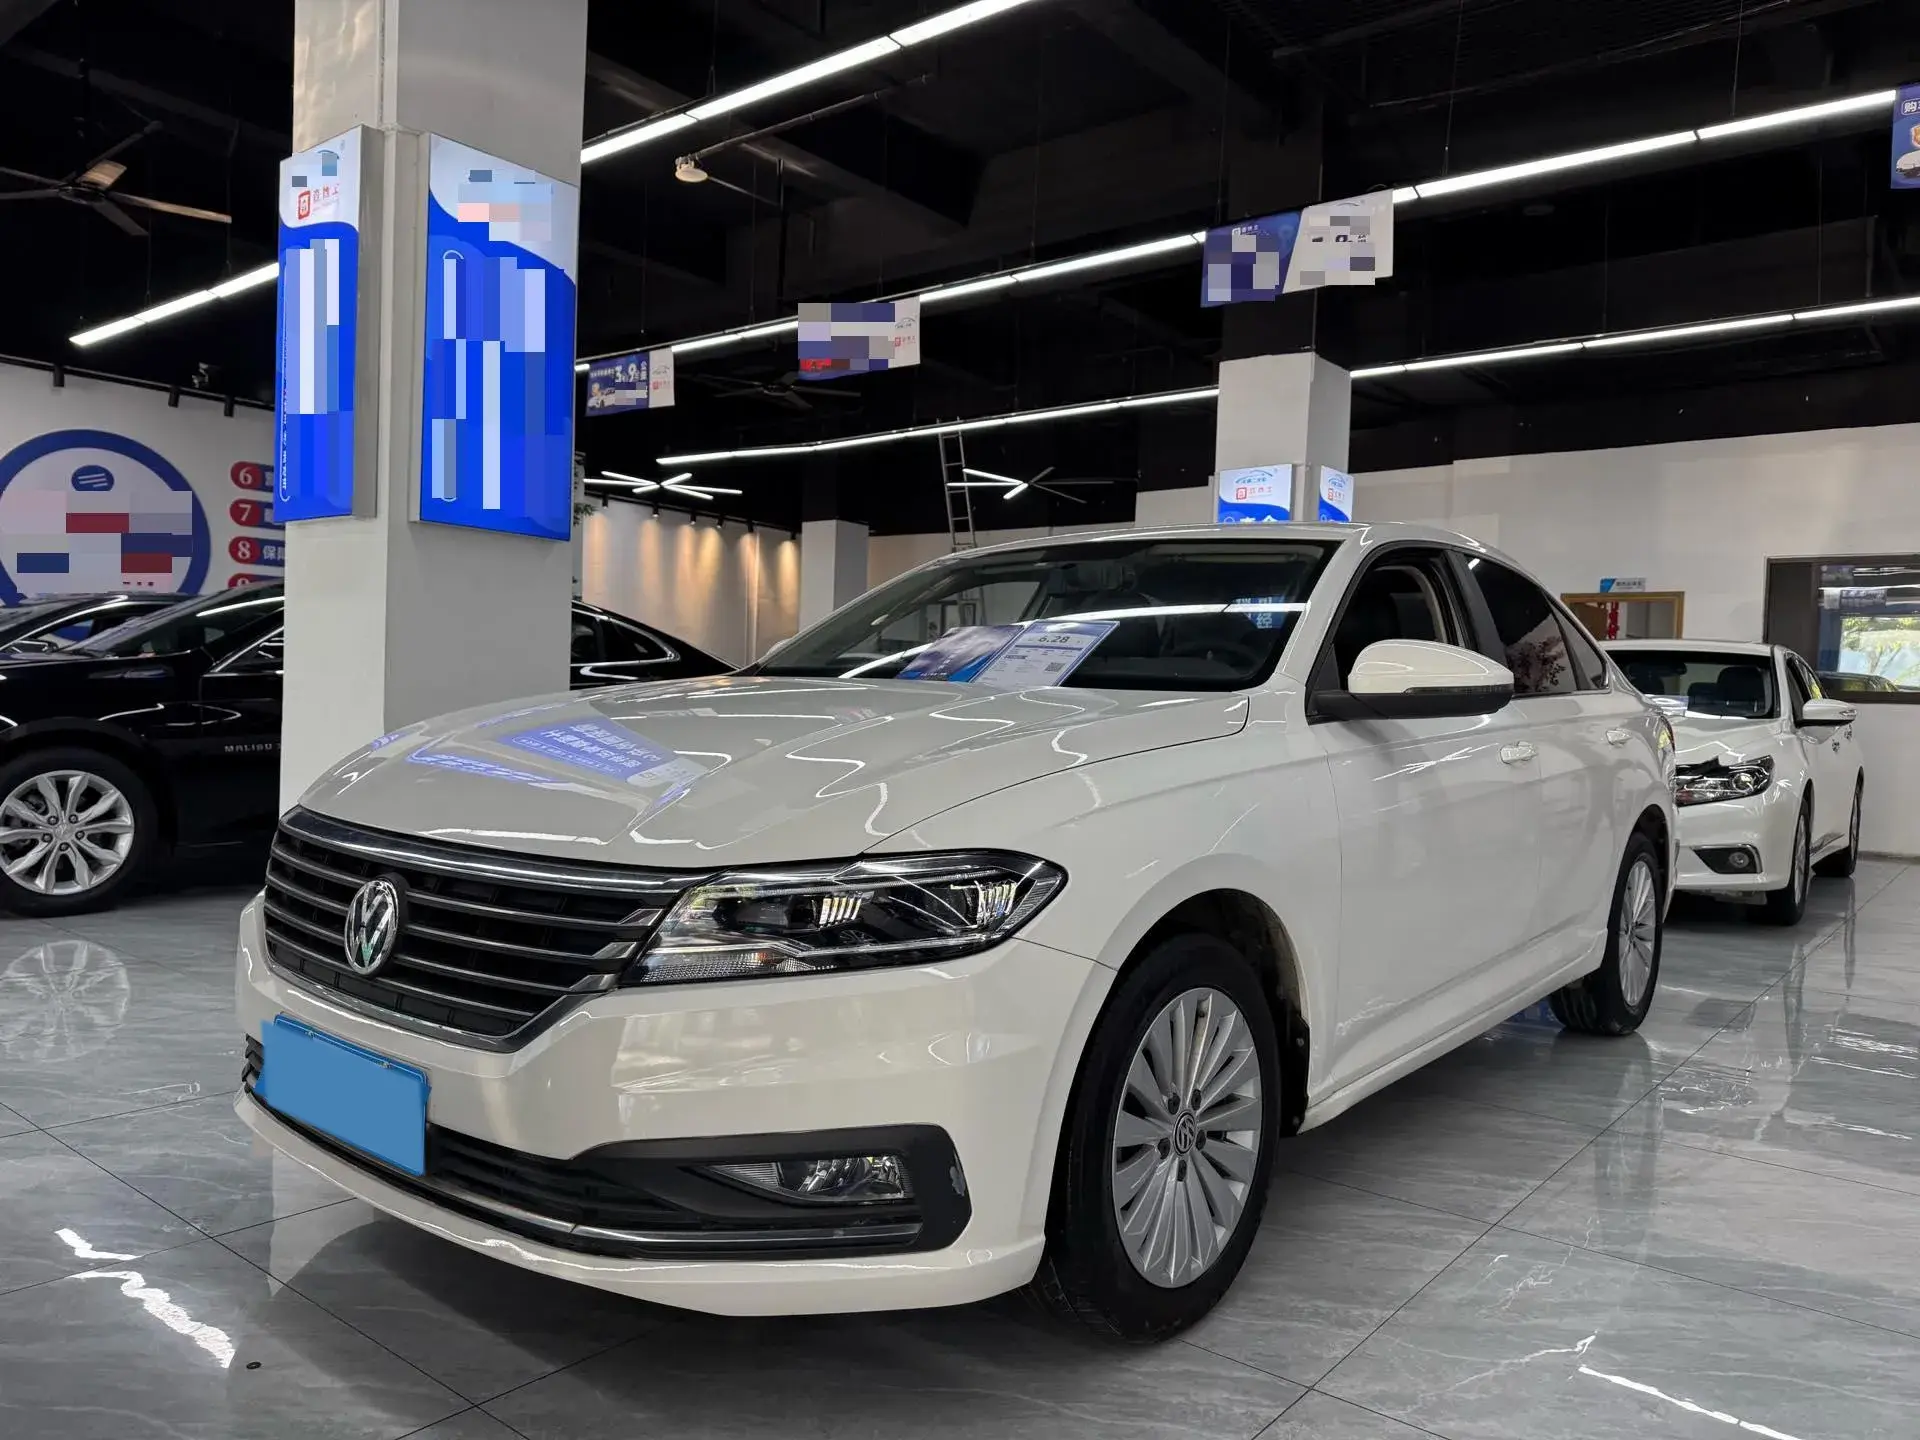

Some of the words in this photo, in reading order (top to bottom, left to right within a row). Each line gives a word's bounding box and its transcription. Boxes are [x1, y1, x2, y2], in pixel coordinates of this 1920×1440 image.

[1904, 101, 1920, 113] 购
[239, 466, 252, 485] 6
[238, 504, 252, 522] 7
[237, 540, 251, 560] 8
[1038, 634, 1070, 643] 6.28
[224, 743, 273, 752] MALIBU
